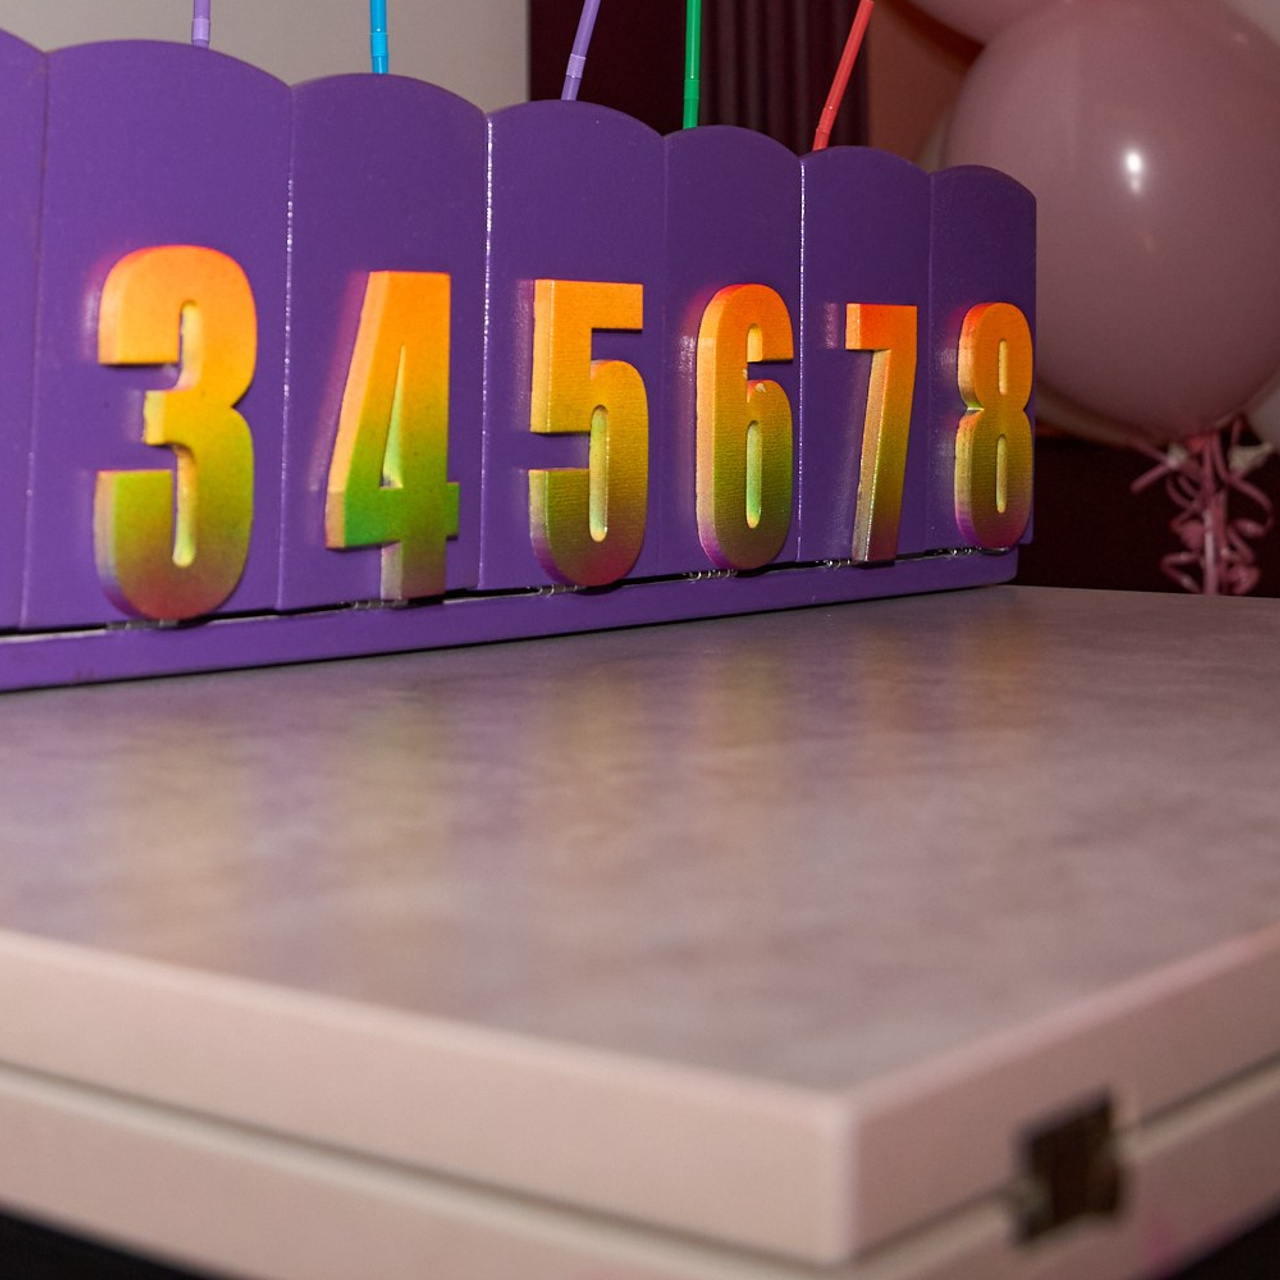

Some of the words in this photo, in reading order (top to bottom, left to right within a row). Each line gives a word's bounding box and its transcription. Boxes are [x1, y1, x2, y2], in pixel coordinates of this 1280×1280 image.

[92, 245, 258, 620] 3
[326, 271, 460, 600] 4
[528, 279, 649, 587] 5
[695, 284, 794, 570] 6
[846, 303, 917, 563] 7
[954, 303, 1034, 550] 8
